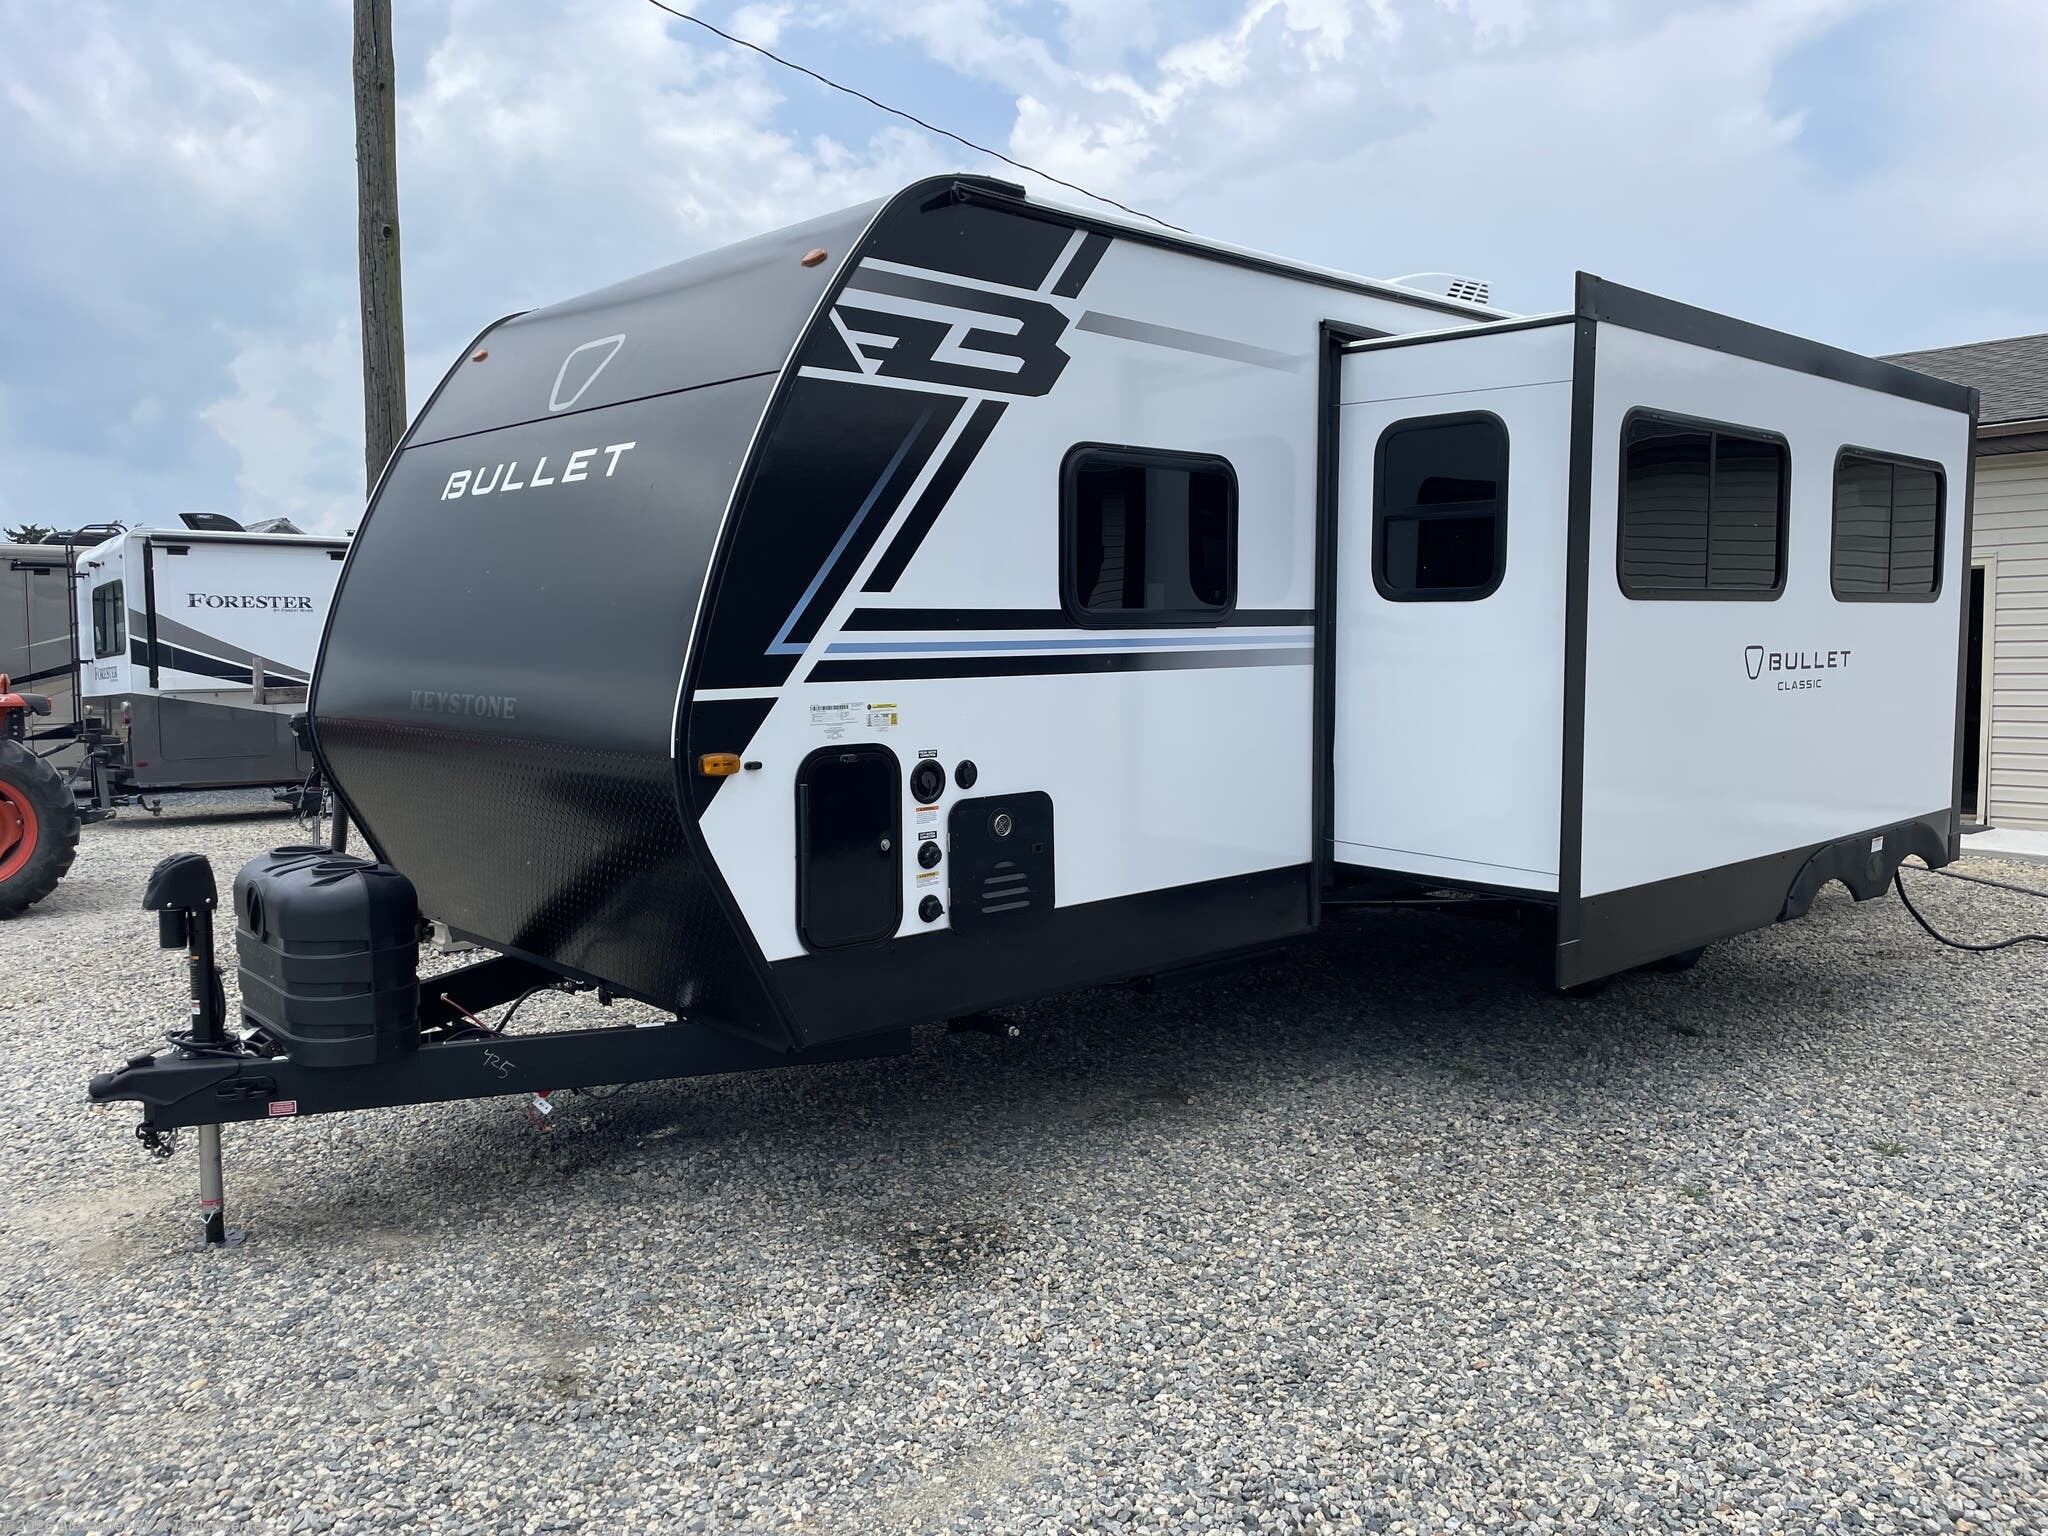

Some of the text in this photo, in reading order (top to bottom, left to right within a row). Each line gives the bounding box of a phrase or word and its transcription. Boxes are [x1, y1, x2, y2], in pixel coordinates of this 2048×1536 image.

[440, 441, 637, 501] BULLET
[187, 593, 313, 609] FORESTER
[1769, 650, 1851, 671] BULLET
[1777, 679, 1822, 691] CLASSIC
[409, 690, 517, 719] KEYSTONE
[483, 1048, 516, 1079] 425
